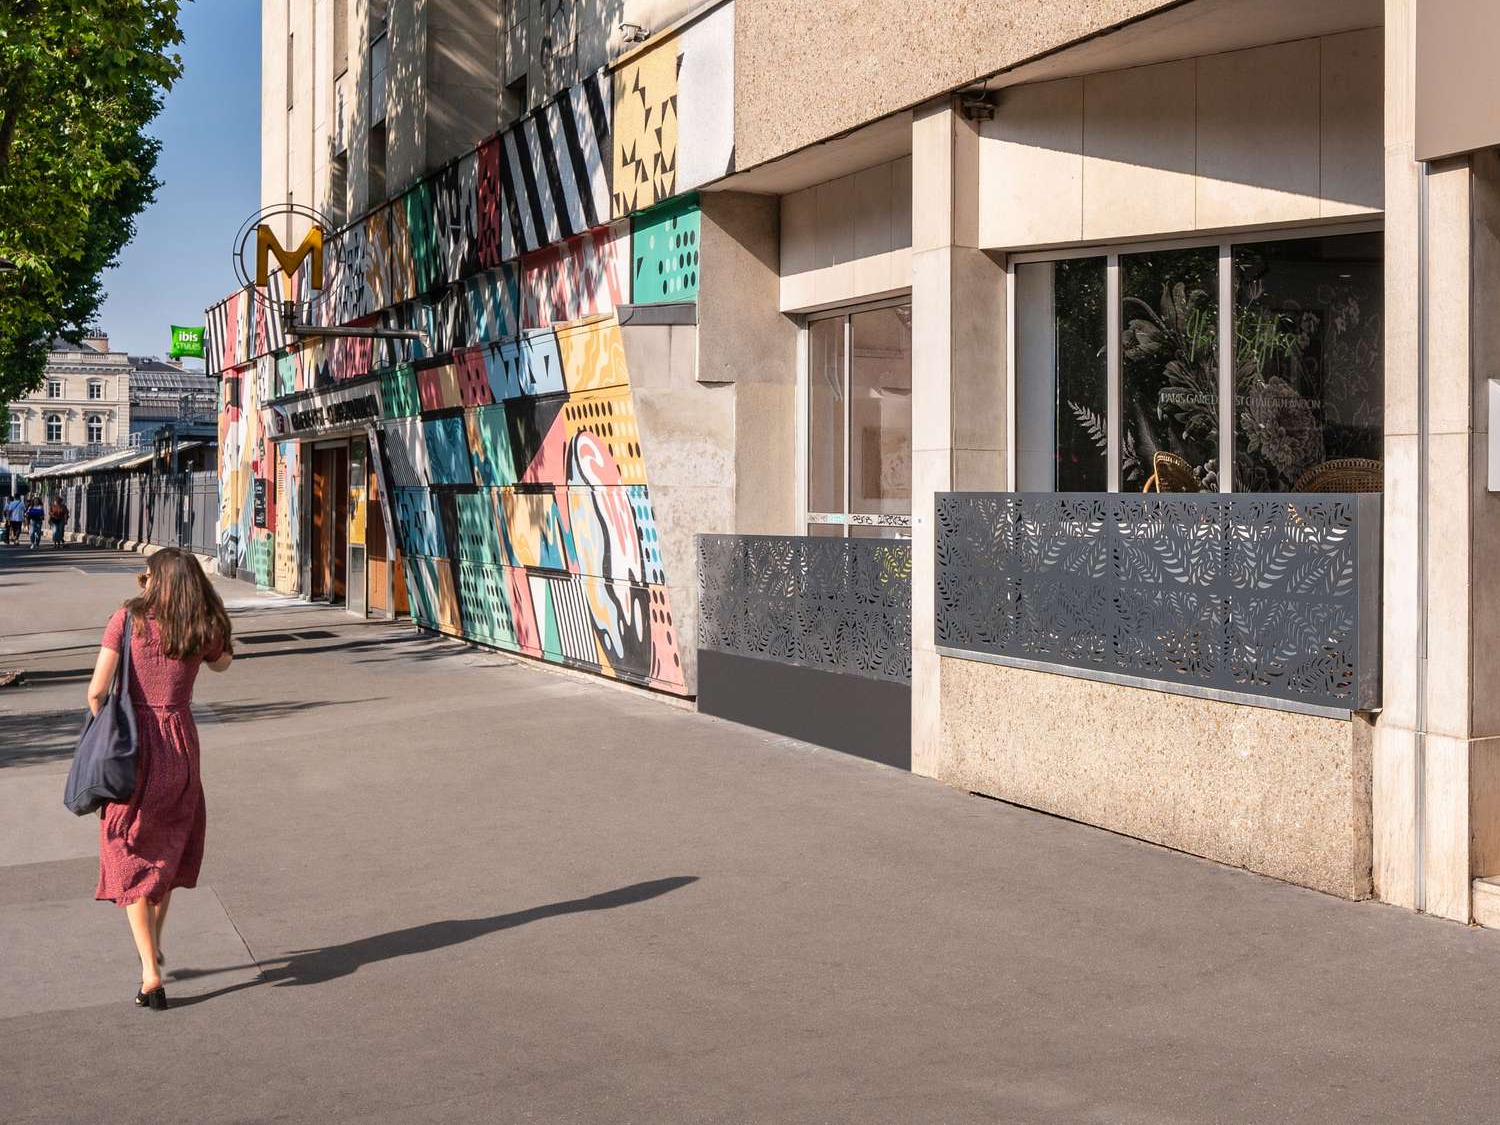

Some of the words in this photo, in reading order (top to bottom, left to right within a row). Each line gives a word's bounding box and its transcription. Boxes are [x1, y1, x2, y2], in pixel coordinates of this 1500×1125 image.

[256, 224, 324, 291] M
[178, 330, 199, 342] ibis
[1160, 392, 1186, 404] PARIS
